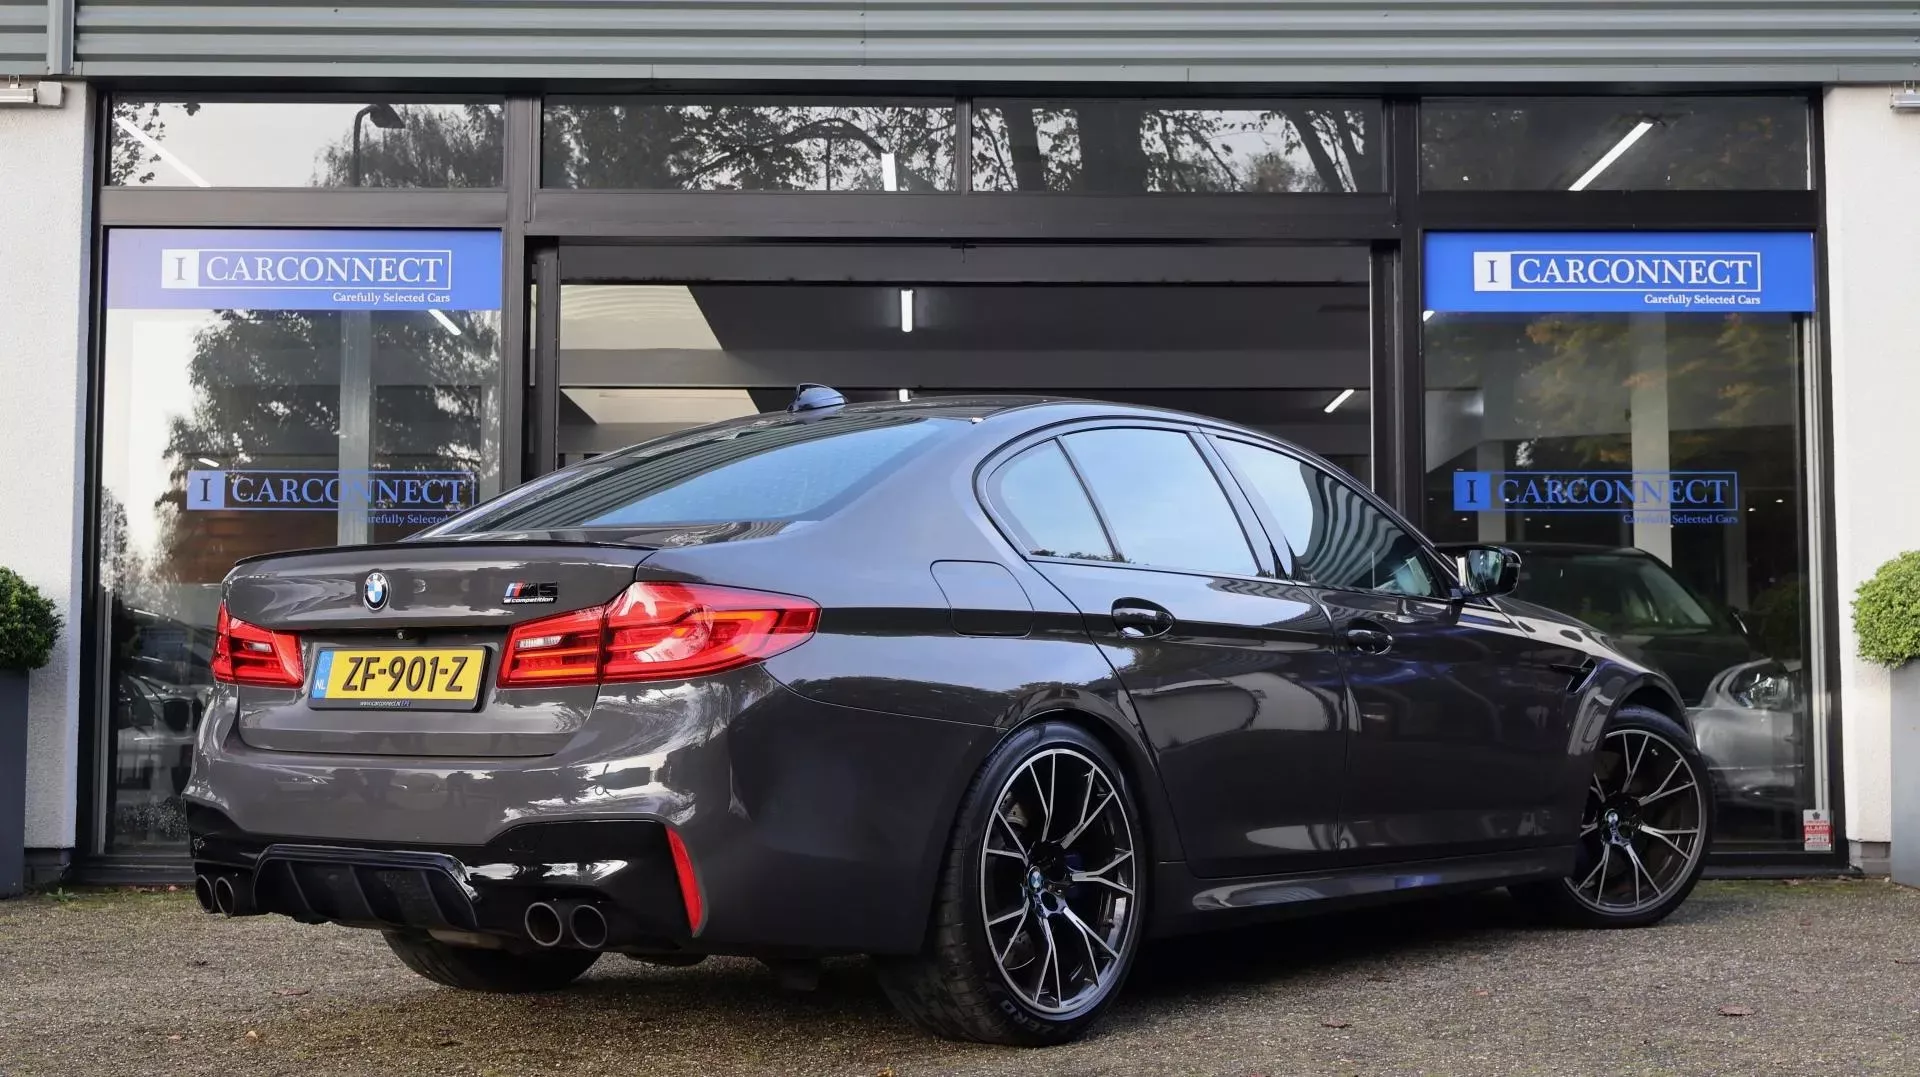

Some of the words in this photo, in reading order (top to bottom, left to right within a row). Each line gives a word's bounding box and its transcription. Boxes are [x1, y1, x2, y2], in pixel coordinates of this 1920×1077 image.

[206, 256, 443, 283] CARCONNECT
[1518, 258, 1752, 285] CARCONNECT
[333, 292, 381, 305] Carefully
[383, 293, 424, 303] Selected
[427, 293, 450, 303] Cars
[1644, 294, 1692, 307] Carefully
[1694, 295, 1736, 304] Selected
[1738, 295, 1760, 304] Cars
[232, 478, 466, 504] CARCONNECT
[1498, 479, 1729, 504] CARCONNECT
[360, 514, 405, 527] arefully
[1672, 514, 1713, 524] Selected
[1715, 514, 1738, 524] Cars
[342, 656, 468, 692] ZF-901-Z
[315, 679, 327, 690] NL
